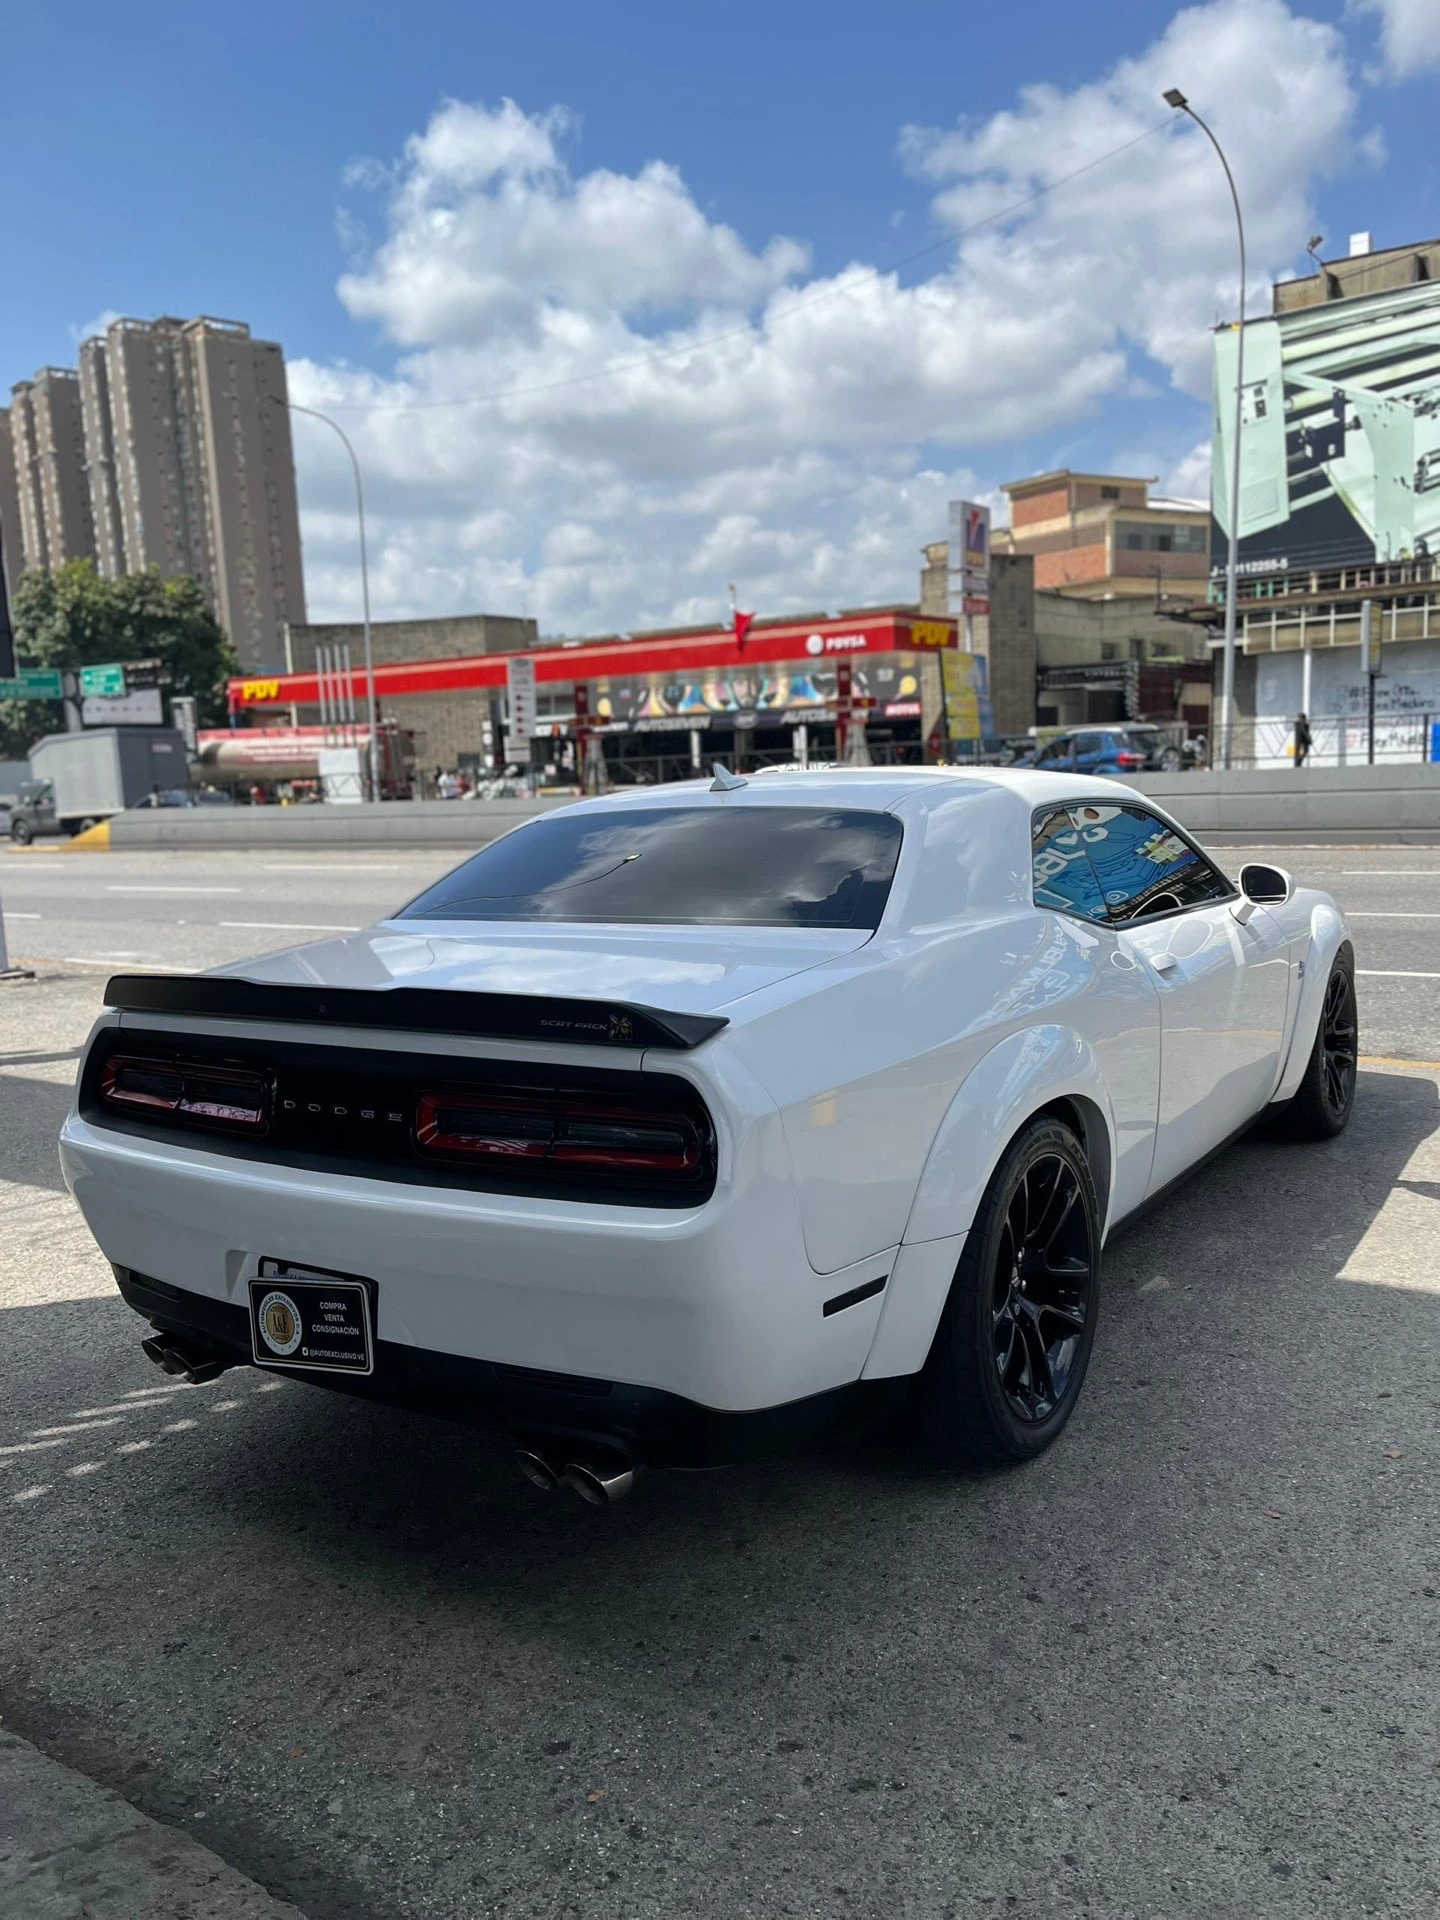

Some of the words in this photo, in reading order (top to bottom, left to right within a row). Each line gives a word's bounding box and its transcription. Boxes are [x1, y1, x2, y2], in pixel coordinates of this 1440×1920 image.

[911, 621, 950, 645] PDV
[243, 680, 279, 700] PDV
[540, 1019, 573, 1028] SCAT
[574, 1022, 608, 1031] PACK
[283, 1100, 402, 1121] DODGE
[260, 1295, 275, 1334] AUTOMOVILES
[274, 1294, 300, 1322] EXCLUSIVOS
[319, 1301, 347, 1311] COMPRA
[323, 1314, 345, 1322] VENTA
[311, 1324, 360, 1336] CONSIGNACIÓN
